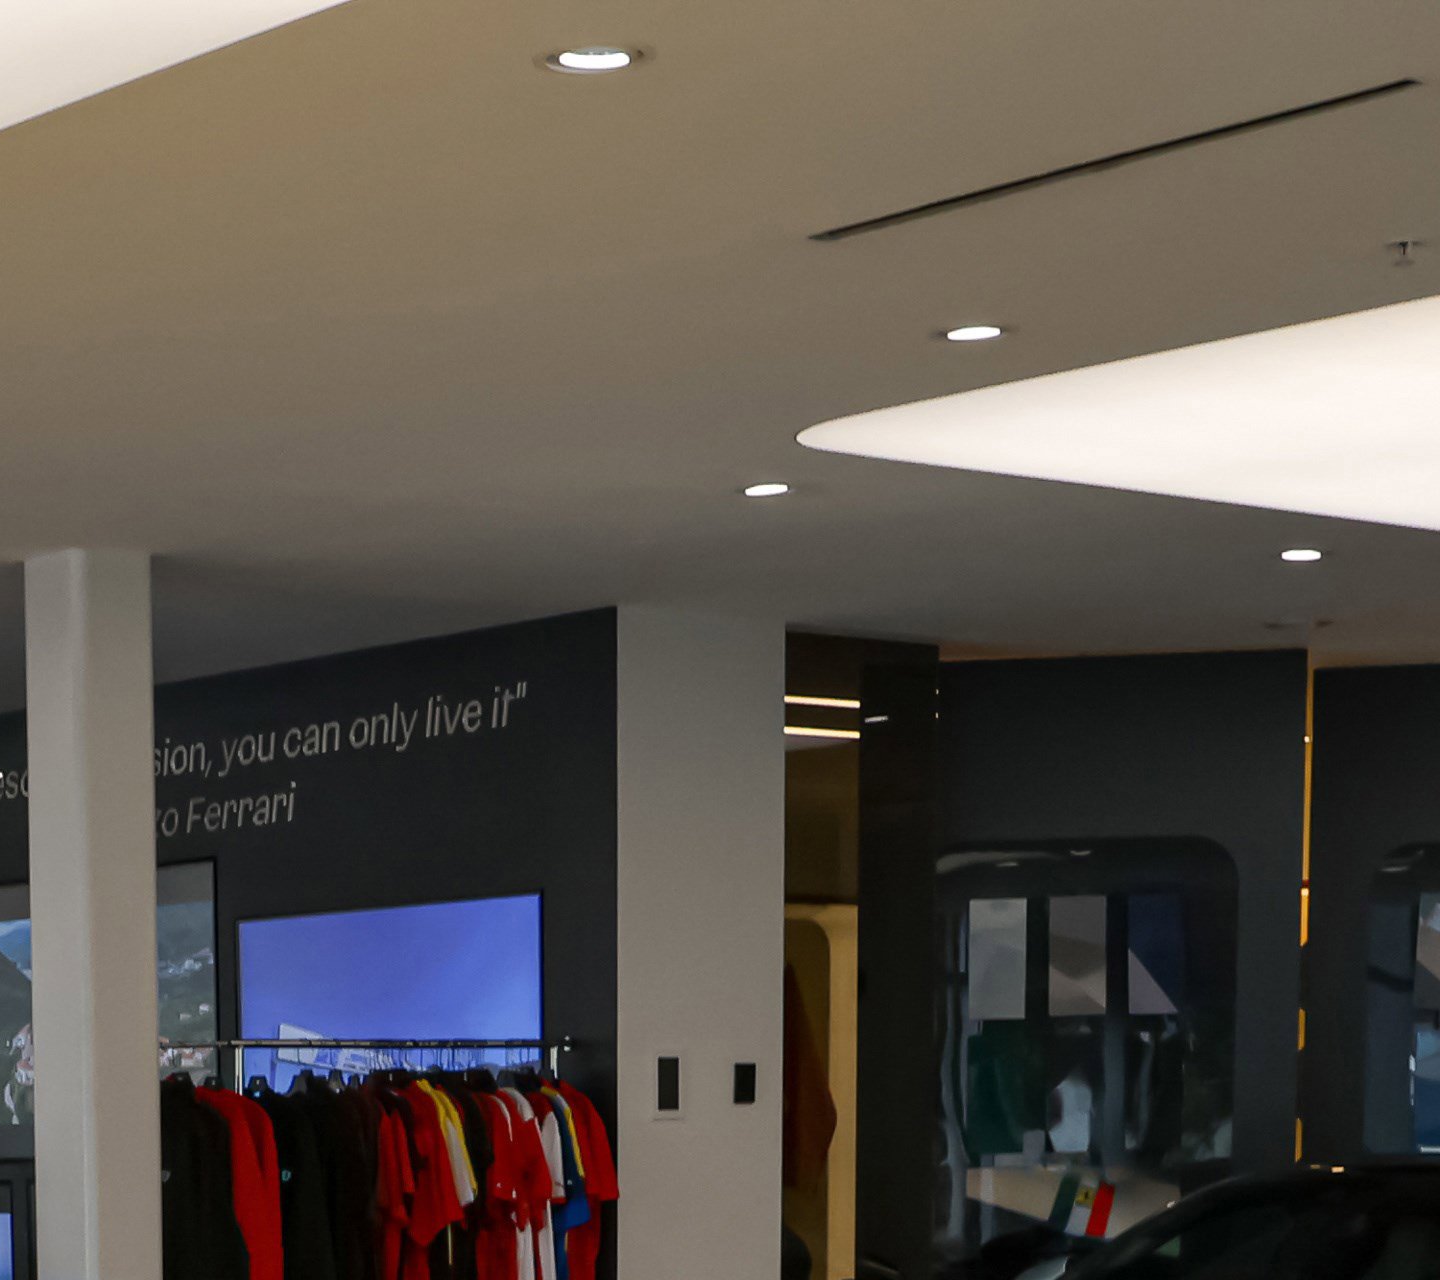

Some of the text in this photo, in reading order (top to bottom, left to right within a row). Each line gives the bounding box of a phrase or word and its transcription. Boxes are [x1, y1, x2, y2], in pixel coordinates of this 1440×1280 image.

[218, 732, 276, 777] you
[283, 720, 340, 759] can
[348, 702, 419, 752] only
[425, 695, 482, 738] live
[186, 780, 296, 834] Ferrari
